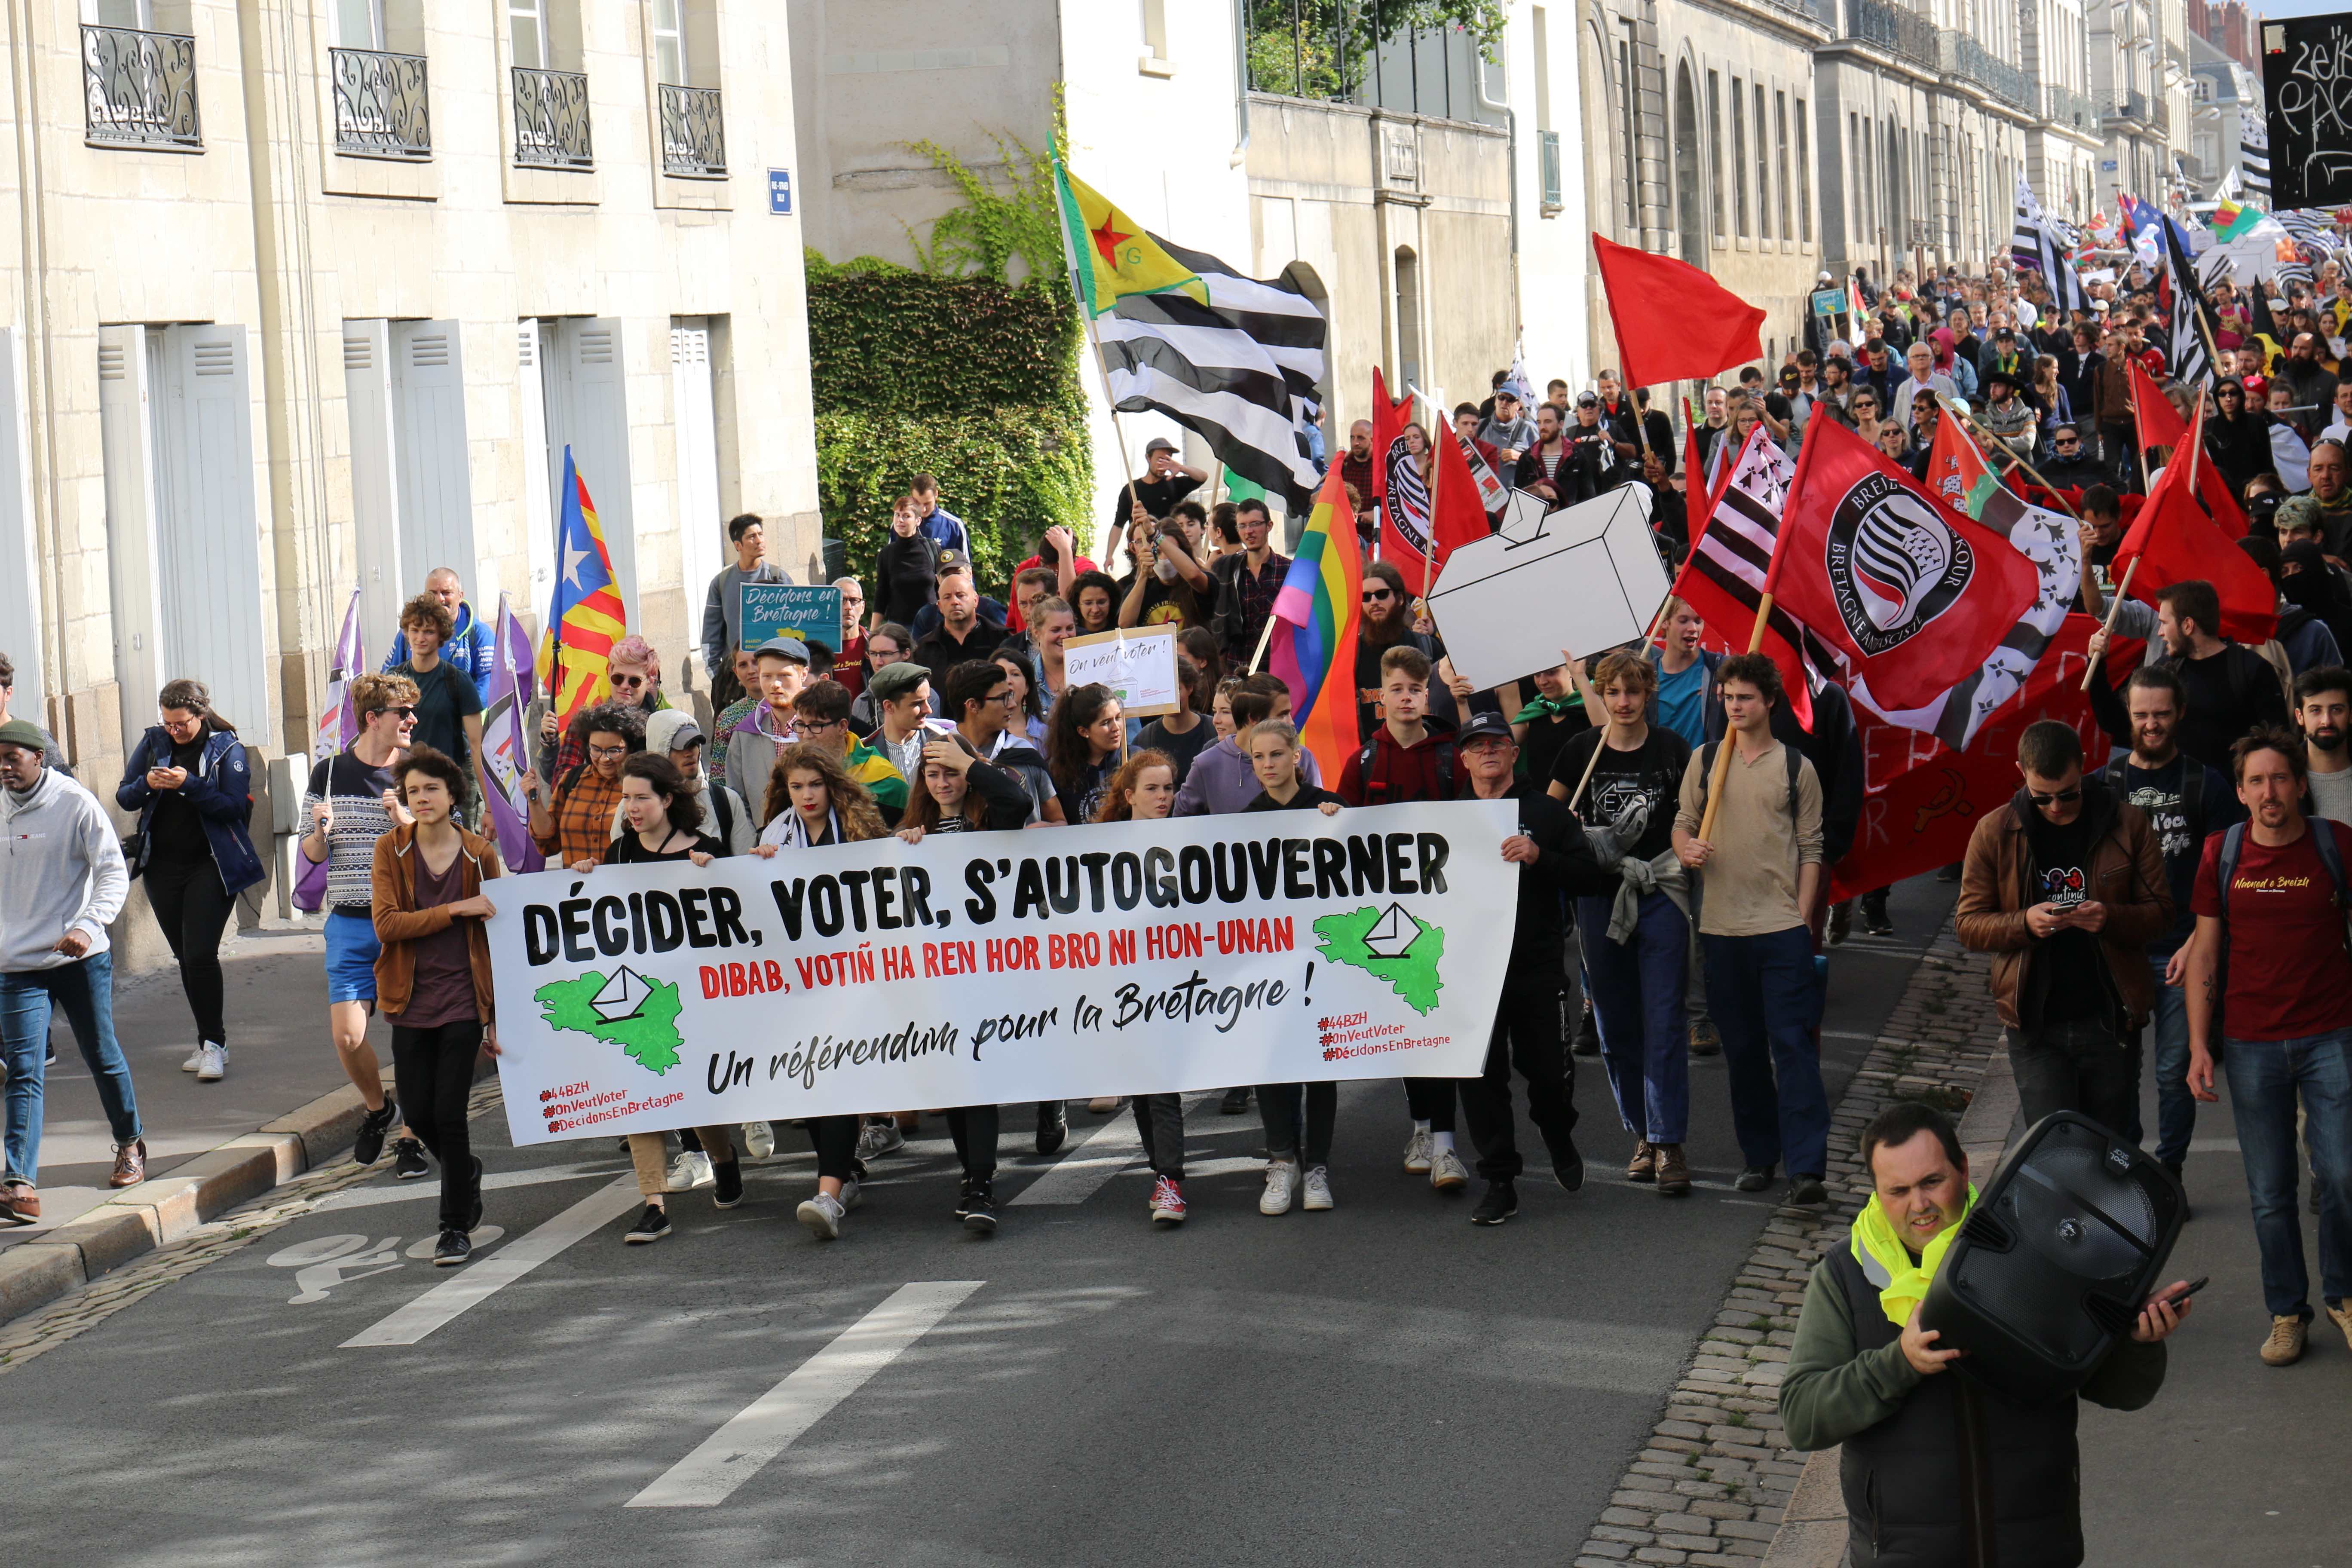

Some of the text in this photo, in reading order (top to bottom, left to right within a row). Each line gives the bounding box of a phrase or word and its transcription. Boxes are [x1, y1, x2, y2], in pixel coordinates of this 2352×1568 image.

[746, 588, 836, 604] Décidons en
[1832, 543, 1866, 635] BRETAGNE
[752, 603, 831, 628] Bretagne !
[1069, 640, 1166, 674] On veut voter !
[2235, 877, 2269, 889] Naoned
[2276, 876, 2309, 888] Breizh
[523, 832, 1449, 967] DÉCIDER, VOTER, S'AUTOGOUVERNER
[699, 916, 1294, 999] DIBAB, VOTIÑ HA REN HOR BRO NI HON-UNAN
[707, 961, 1314, 1095] Un référendum pour la Bretagne !
[1317, 1011, 1368, 1031] #44BZH
[1319, 1024, 1406, 1047] #OnVeutVoter
[1323, 1036, 1451, 1061] #DécidonsEnBretagne
[539, 1080, 590, 1102] #44BZH
[543, 1089, 628, 1118] #OnVeutVoter
[548, 1092, 684, 1133] #DécidonsEnBretagne
